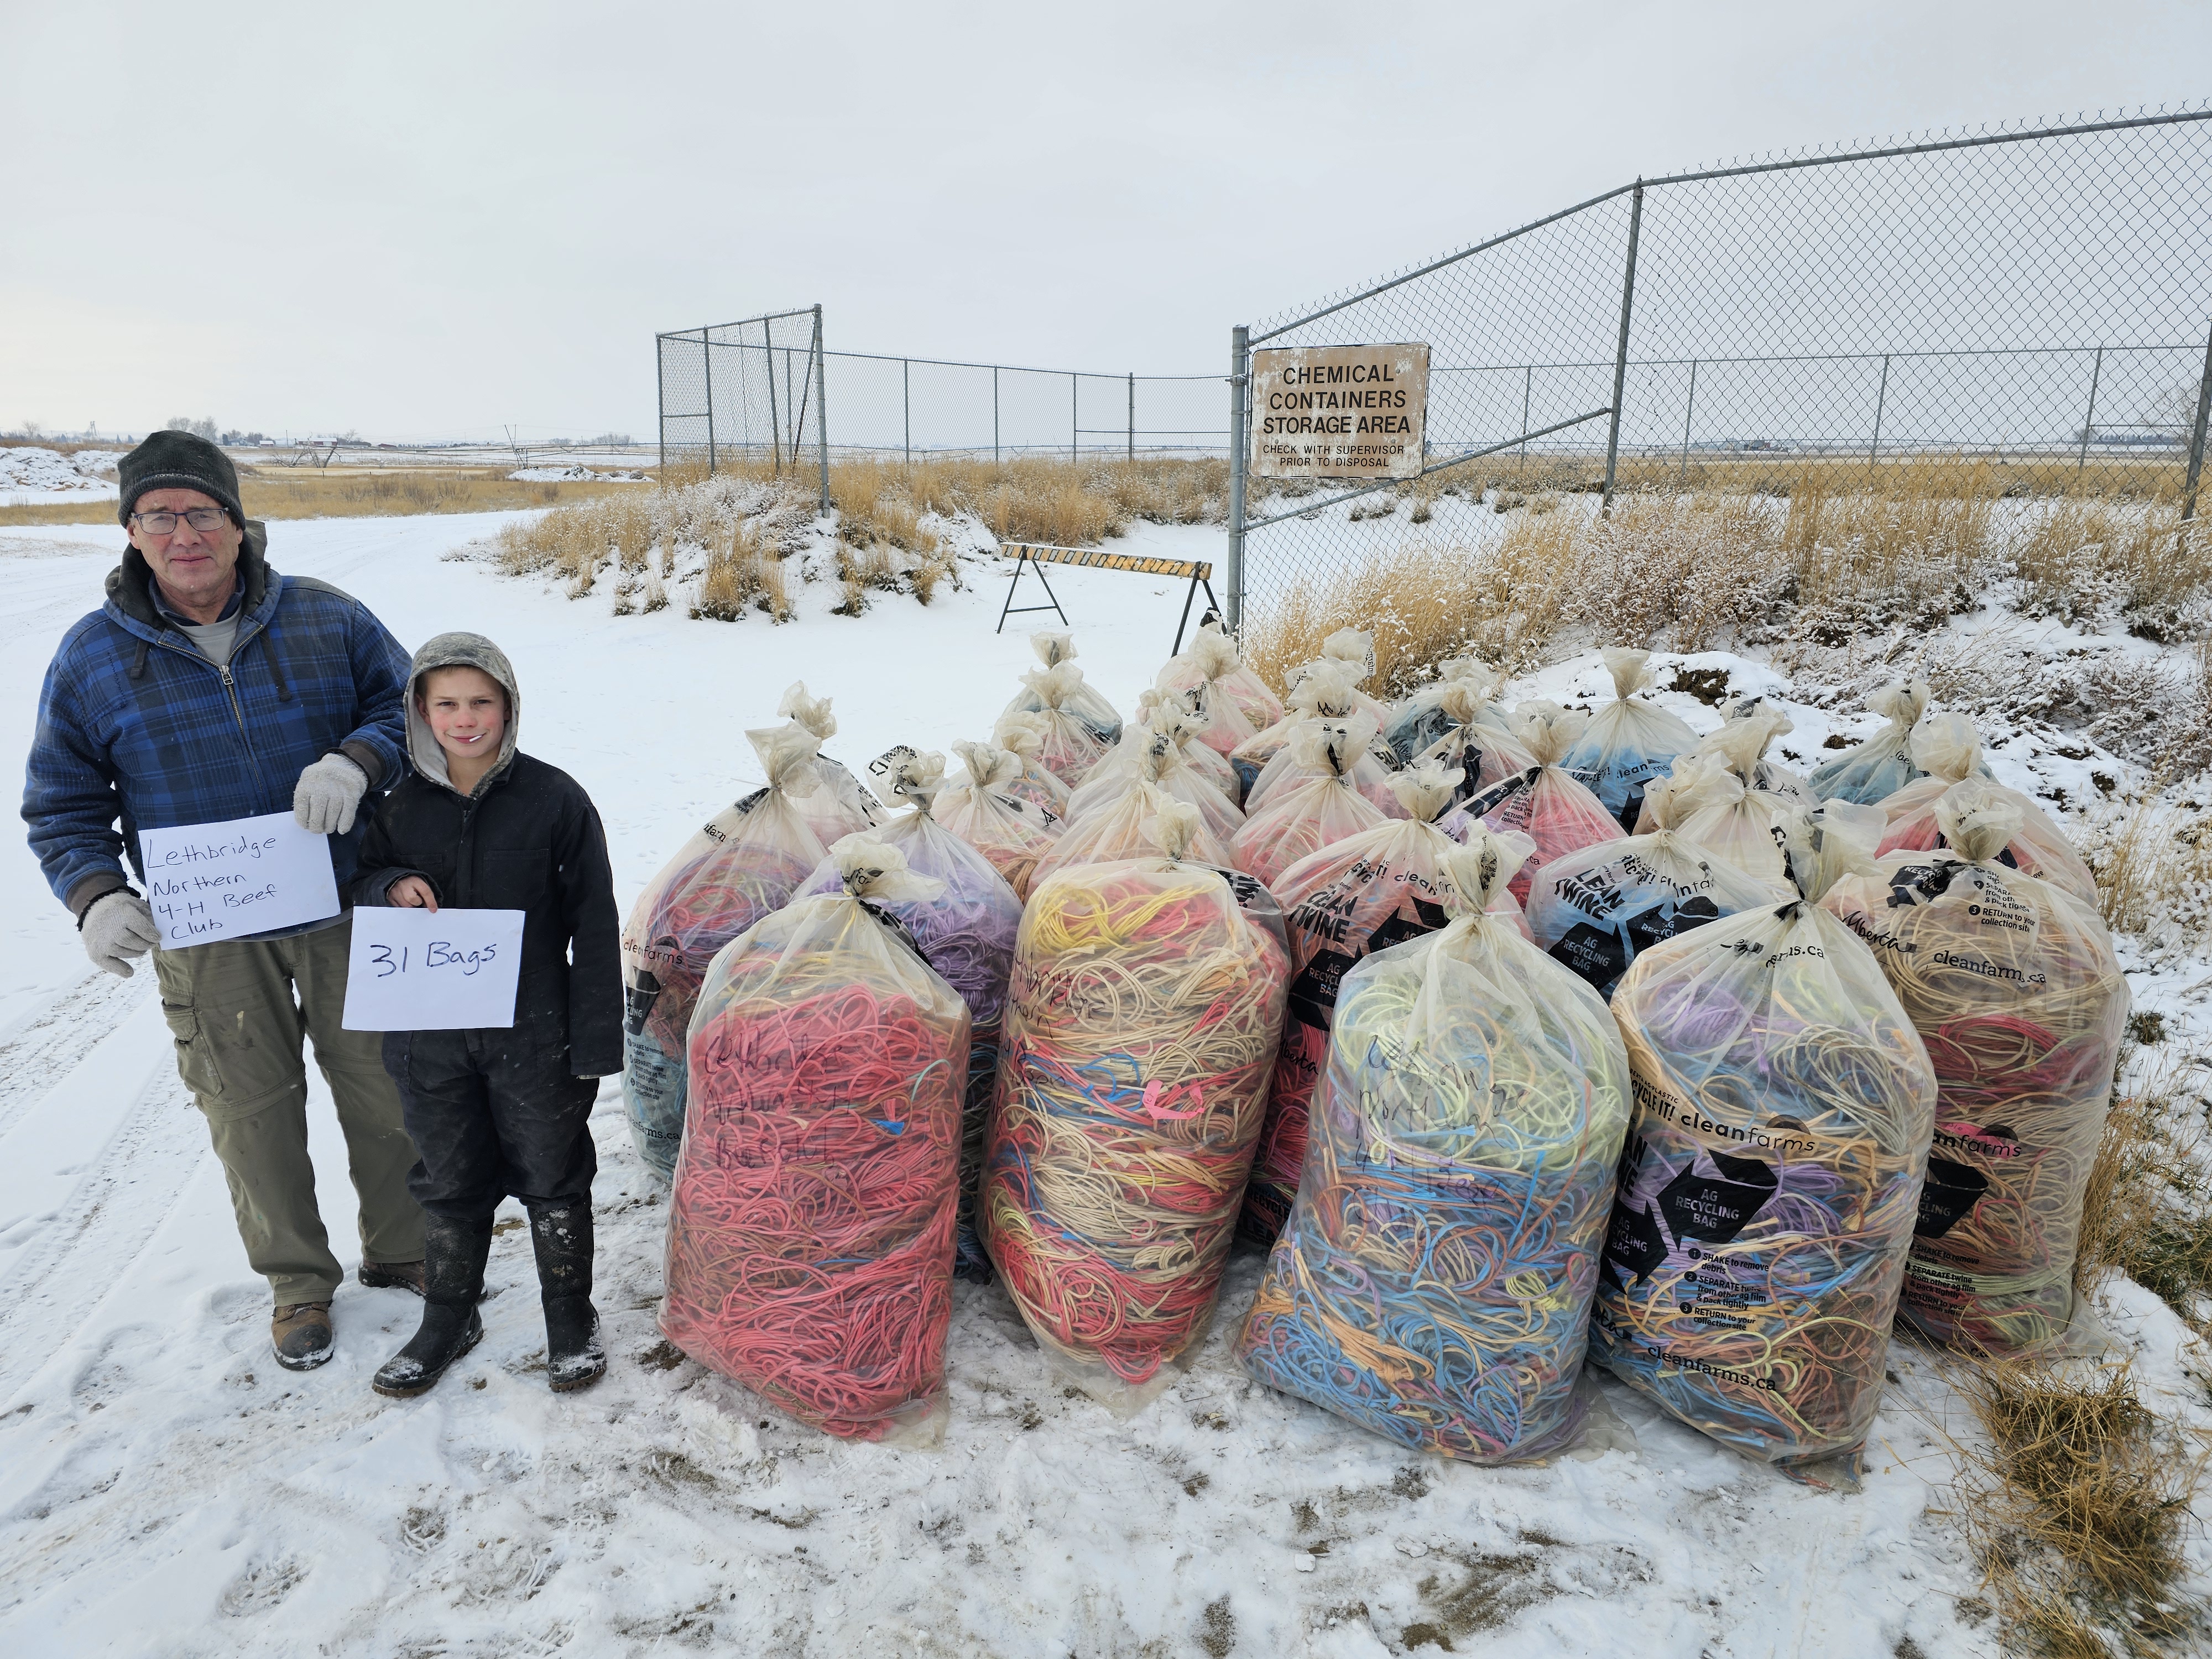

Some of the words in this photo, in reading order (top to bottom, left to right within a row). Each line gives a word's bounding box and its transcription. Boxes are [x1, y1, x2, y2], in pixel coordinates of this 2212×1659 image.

[1283, 364, 1394, 385] CHEMICAL
[1270, 389, 1406, 410] CONTAINERS
[1263, 416, 1352, 434] STORAGE
[1357, 416, 1411, 434] AREA
[1263, 445, 1297, 454] CHECK
[1304, 445, 1331, 455] WITH
[1336, 445, 1405, 455] SUPERVISOR
[1280, 458, 1311, 467] PRIOR
[1318, 458, 1330, 467] TO
[1336, 458, 1389, 467] DISPOSAL
[148, 836, 276, 868] Lethbridge
[154, 874, 247, 896] Northern
[1574, 868, 1626, 910] LEAN
[158, 901, 204, 920] 4-H
[223, 884, 278, 907] Beef
[1554, 878, 1613, 921] TWINE
[1287, 904, 1350, 944] TWINE
[1981, 918, 2017, 930] collection
[2018, 924, 2030, 933] site
[1983, 907, 2013, 920] RETURN
[2023, 917, 2036, 927] your
[171, 919, 223, 940] Club
[1841, 911, 1912, 952] Alberta
[1583, 936, 1598, 949] AG
[370, 945, 408, 978] 31
[426, 941, 497, 976] Bags
[1563, 938, 1610, 967] RECYCLING
[1327, 963, 1341, 975] AG
[1572, 955, 1591, 972] BAG
[1309, 968, 1339, 986] RECYCL
[649, 1047, 664, 1056] remove
[634, 1058, 652, 1069] SEPARATE
[645, 1076, 658, 1085] tightly
[658, 1072, 666, 1080] film
[635, 1081, 649, 1091] RETURN
[653, 1087, 664, 1095] your
[635, 1089, 653, 1098] collection
[1629, 1068, 1644, 1083] BERTA
[1644, 1079, 1679, 1104] AG-PLASTIC
[1632, 1079, 1657, 1112] CYCLE
[1658, 1099, 1676, 1121] IT!
[1681, 1113, 1815, 1151] cleanfarms
[1932, 1132, 2022, 1157] anfarms
[1700, 1189, 1718, 1202] AG
[1675, 1196, 1740, 1220] RECYCLING
[1918, 1201, 1952, 1217] CLING
[1618, 1216, 1630, 1231] AG
[1693, 1213, 1718, 1229] BAG
[1611, 1238, 1630, 1256] BAG
[1916, 1245, 1942, 1257] SHAKE
[1943, 1251, 1951, 1259] to
[1952, 1254, 1980, 1265] remove
[1703, 1253, 1730, 1265] SHAKE
[1731, 1258, 1740, 1267] to
[1740, 1260, 1769, 1272] remove
[1914, 1253, 1938, 1265] debris
[1701, 1262, 1726, 1275] debris
[1912, 1265, 1950, 1280] SEPARATE
[1952, 1274, 1973, 1284] twine
[1699, 1276, 1740, 1291] SEPARATE
[1911, 1272, 1929, 1283] from
[1930, 1279, 1951, 1288] other
[1952, 1284, 1961, 1292] ag
[1961, 1284, 1976, 1293] film
[1916, 1283, 1934, 1293] pack
[1935, 1287, 1960, 1300] tightly
[1696, 1293, 1702, 1302] &
[1703, 1296, 1721, 1305] pack
[1723, 1298, 1749, 1311] tightly
[1697, 1284, 1717, 1295] from
[1718, 1290, 1738, 1298] other
[1739, 1291, 1750, 1300] ag
[1750, 1292, 1767, 1303] film
[1908, 1291, 1939, 1305] RETURN
[1694, 1307, 1727, 1320] RETURN
[1908, 1299, 1943, 1313] collection
[1693, 1316, 1731, 1329] collection
[1732, 1323, 1747, 1331] site
[1647, 1345, 1777, 1391] cleanfarms.ca
